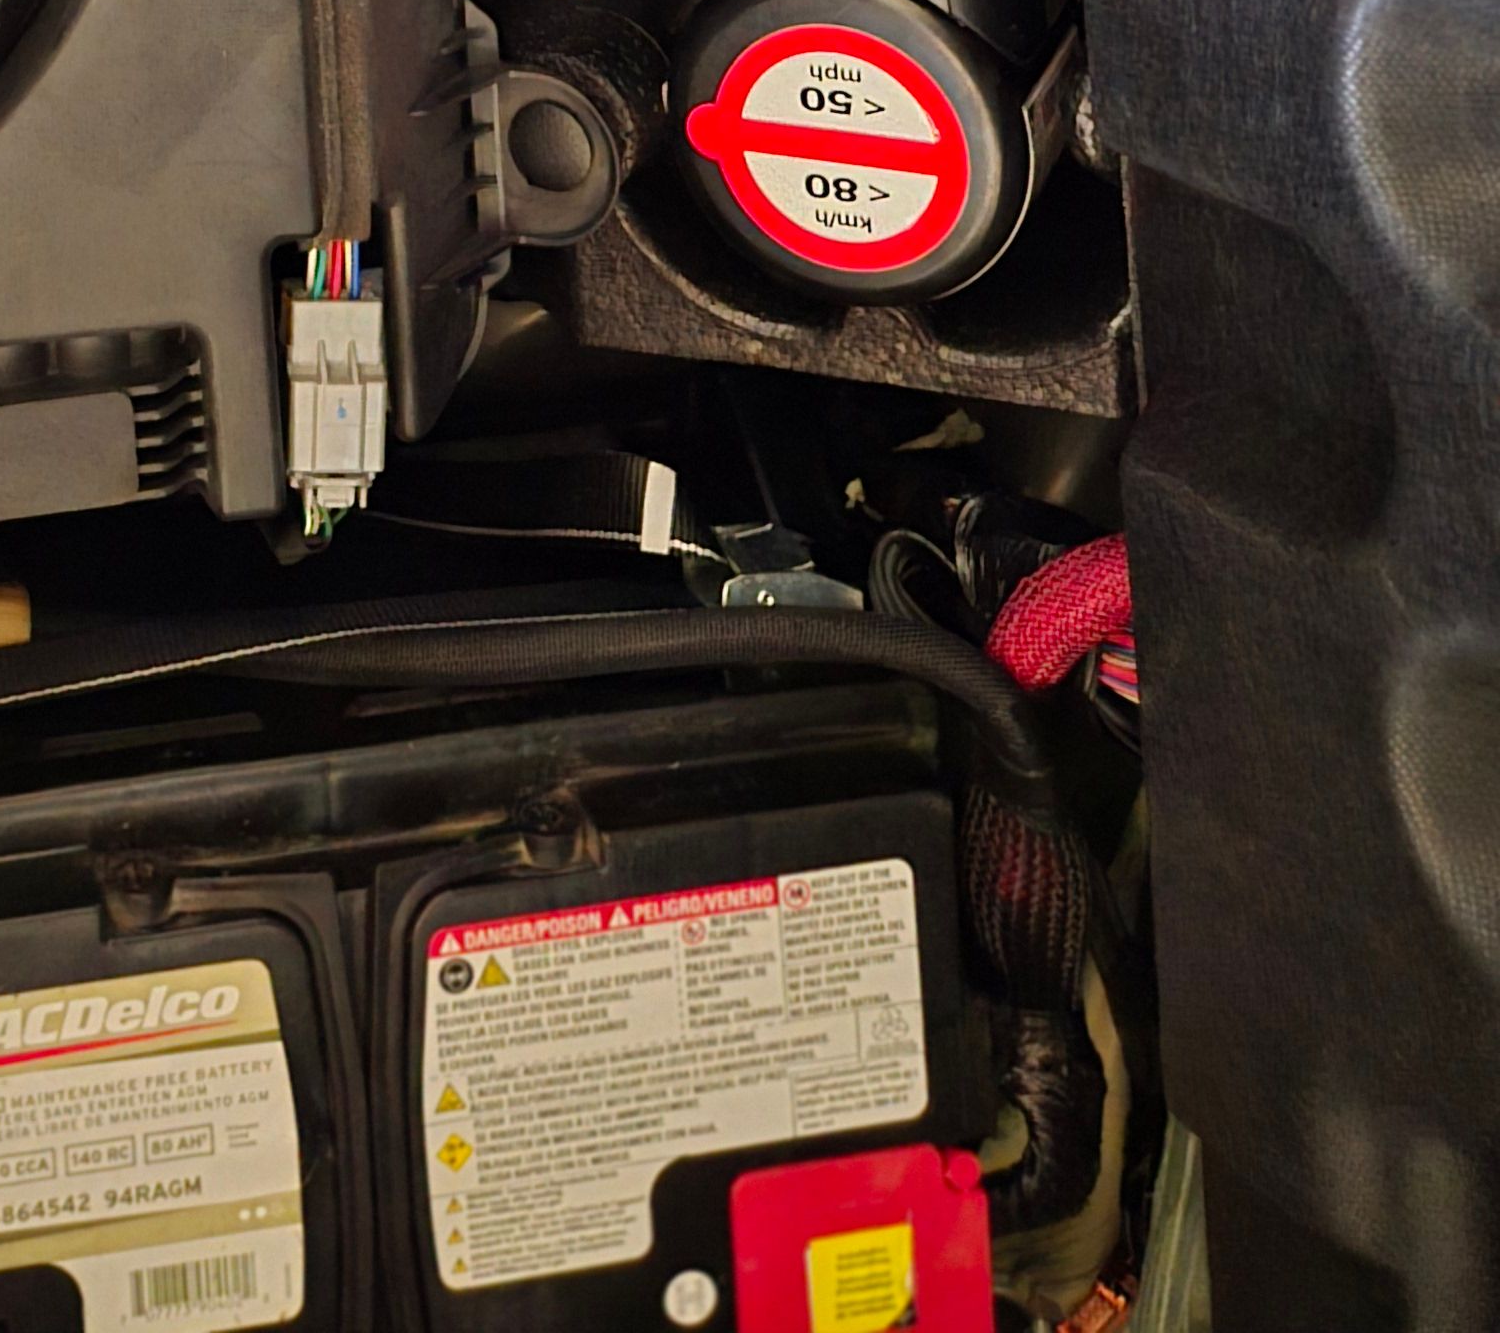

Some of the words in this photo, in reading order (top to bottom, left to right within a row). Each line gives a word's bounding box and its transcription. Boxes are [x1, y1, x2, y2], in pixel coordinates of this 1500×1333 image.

[810, 63, 861, 83] mph
[800, 87, 852, 115] 50
[805, 174, 858, 202] 80
[815, 209, 872, 233] km/h
[462, 914, 601, 950] DANGER/POISON
[633, 886, 773, 924] PELIGRO/VENENO
[11, 1078, 138, 1110] MAINTENANCE
[145, 1070, 189, 1090] FREE
[195, 1058, 274, 1082] BATTERY
[36, 1118, 78, 1138] LIBRE
[86, 1114, 102, 1128] DE
[109, 1094, 232, 1126] MANTENIMIENTO
[238, 1090, 270, 1106] AGM
[44, 1102, 83, 1117] SANS
[88, 1090, 171, 1114] ENTRETIEN
[177, 1085, 208, 1100] AGM
[72, 1150, 102, 1167] 140
[107, 1145, 130, 1161] RC
[151, 1138, 171, 1154] 80
[16, 1158, 49, 1177] CCA
[104, 1176, 202, 1208] 94RAGM
